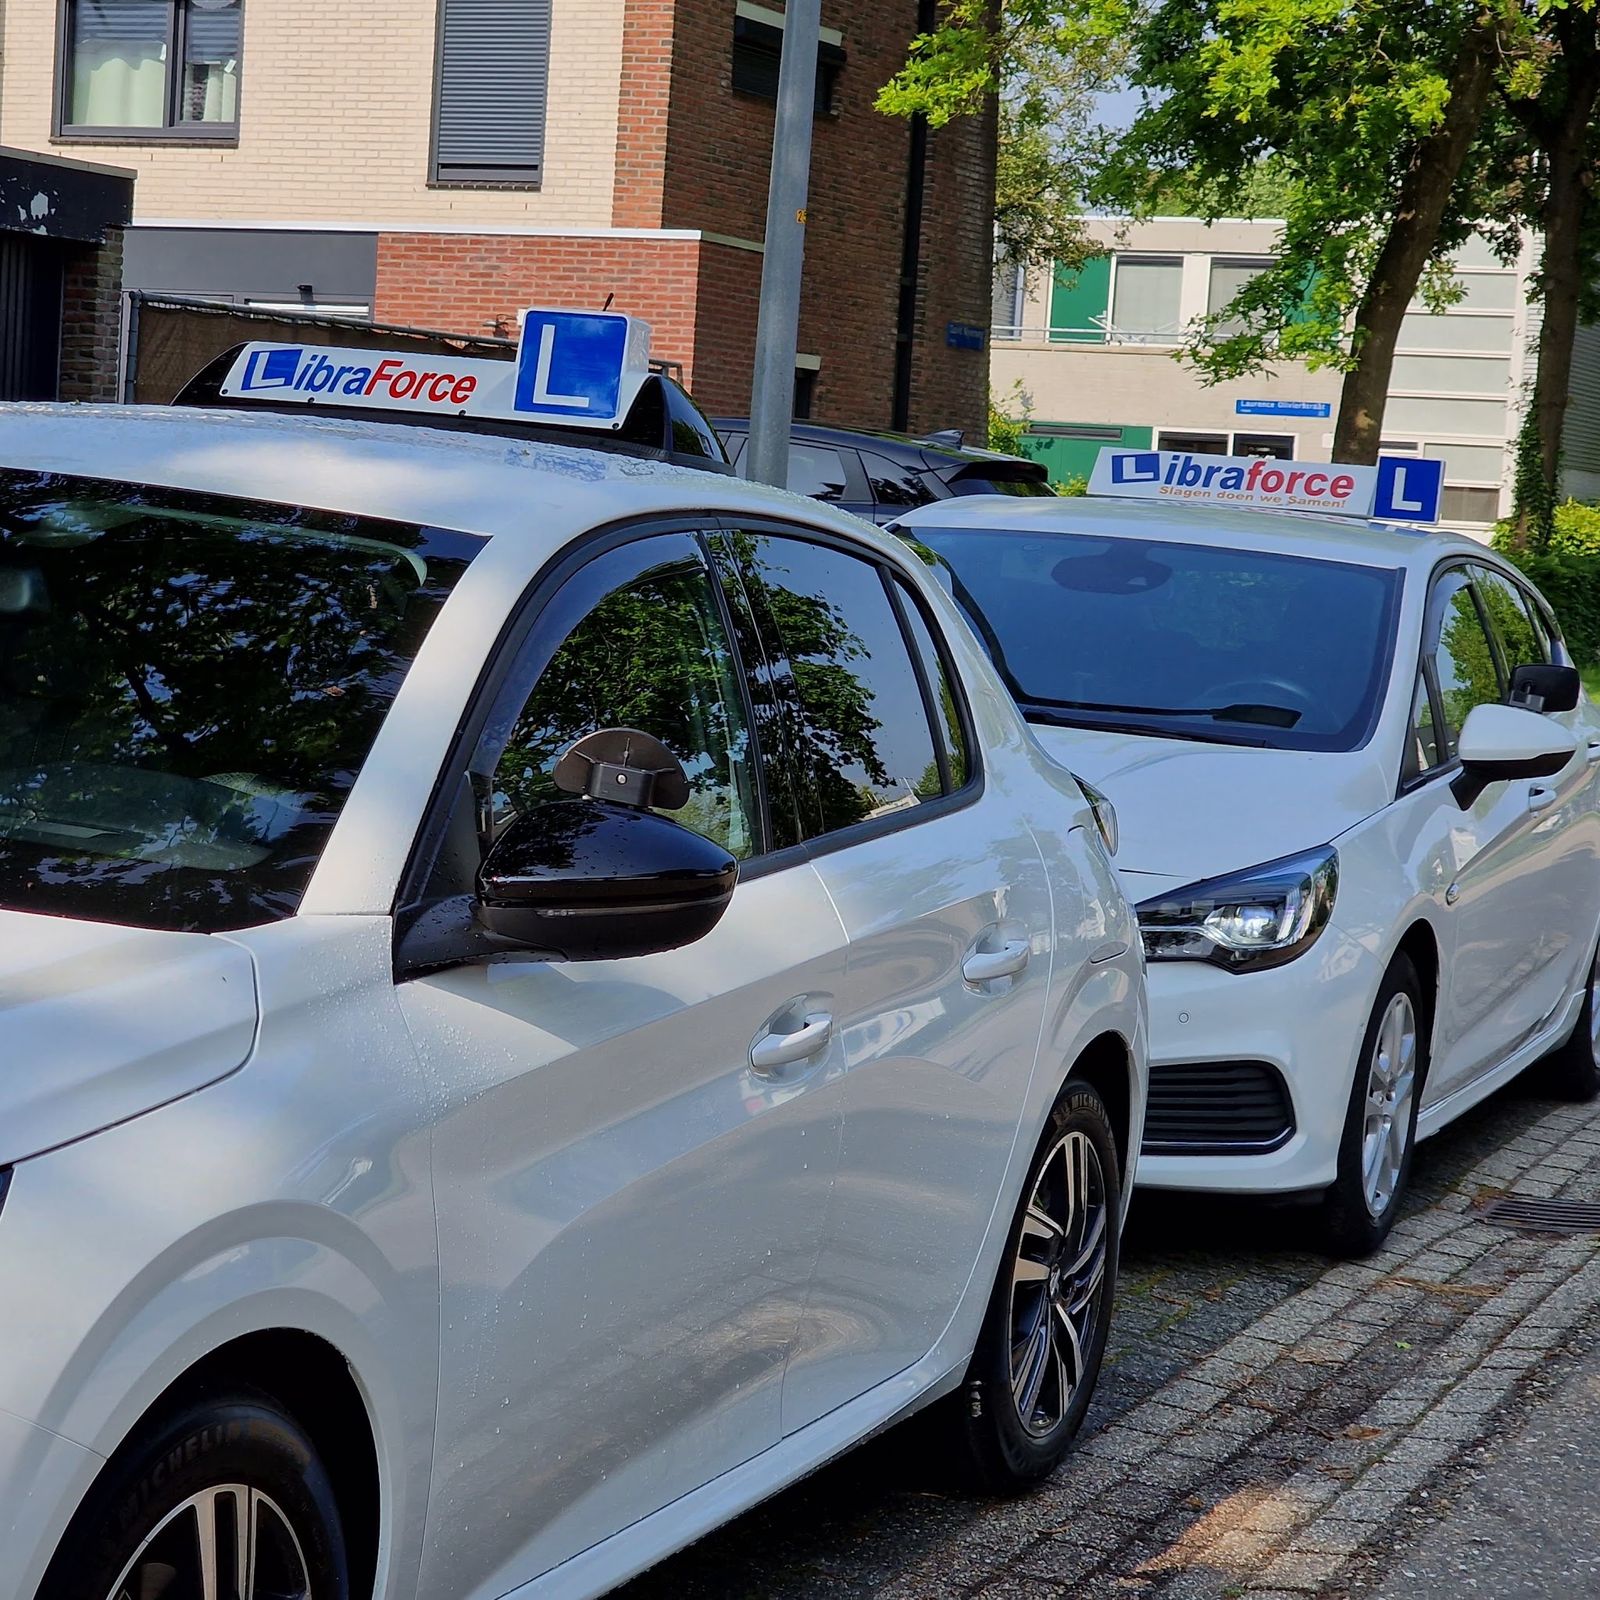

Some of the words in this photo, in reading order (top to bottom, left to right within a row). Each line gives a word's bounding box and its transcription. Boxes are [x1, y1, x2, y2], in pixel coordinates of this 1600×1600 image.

[246, 349, 477, 404] LibraForce
[533, 324, 590, 408] L
[1240, 400, 1275, 408] Laurence
[1113, 454, 1355, 498] Libraforce
[1159, 486, 1211, 499] Slagen
[1216, 490, 1254, 502] doen
[1260, 495, 1282, 504] we
[1288, 495, 1346, 508] Samen!
[1391, 467, 1422, 511] L
